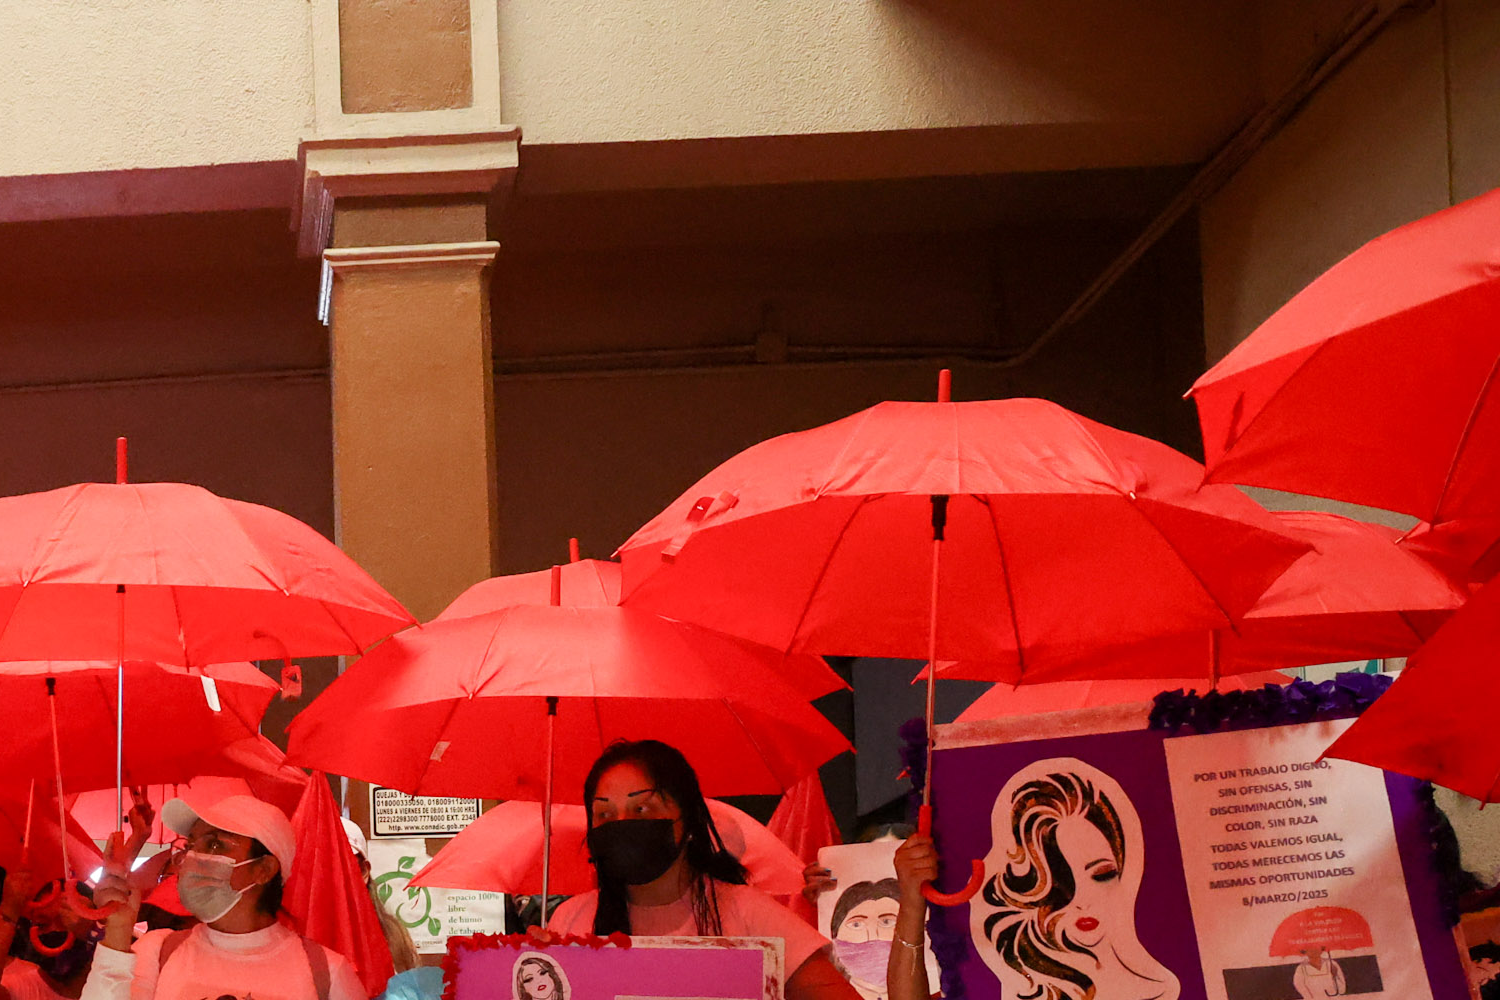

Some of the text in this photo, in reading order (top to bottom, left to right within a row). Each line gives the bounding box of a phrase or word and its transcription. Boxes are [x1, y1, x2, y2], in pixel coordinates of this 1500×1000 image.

[1194, 759, 1332, 782] POR UN TRABAJO DIGNO,
[1218, 780, 1312, 798] SIN OFENSAS, SIN
[1209, 796, 1327, 816] DISCRIMINACIÓN, SIN
[1225, 815, 1318, 832] COLOR, SIN RAZA
[1210, 832, 1343, 853] TODAS VALEMOS IGUAL,
[1212, 849, 1346, 871] TODAS MERECEMOS LAS
[1209, 866, 1355, 890] MISMAS OPORTUNIDADES
